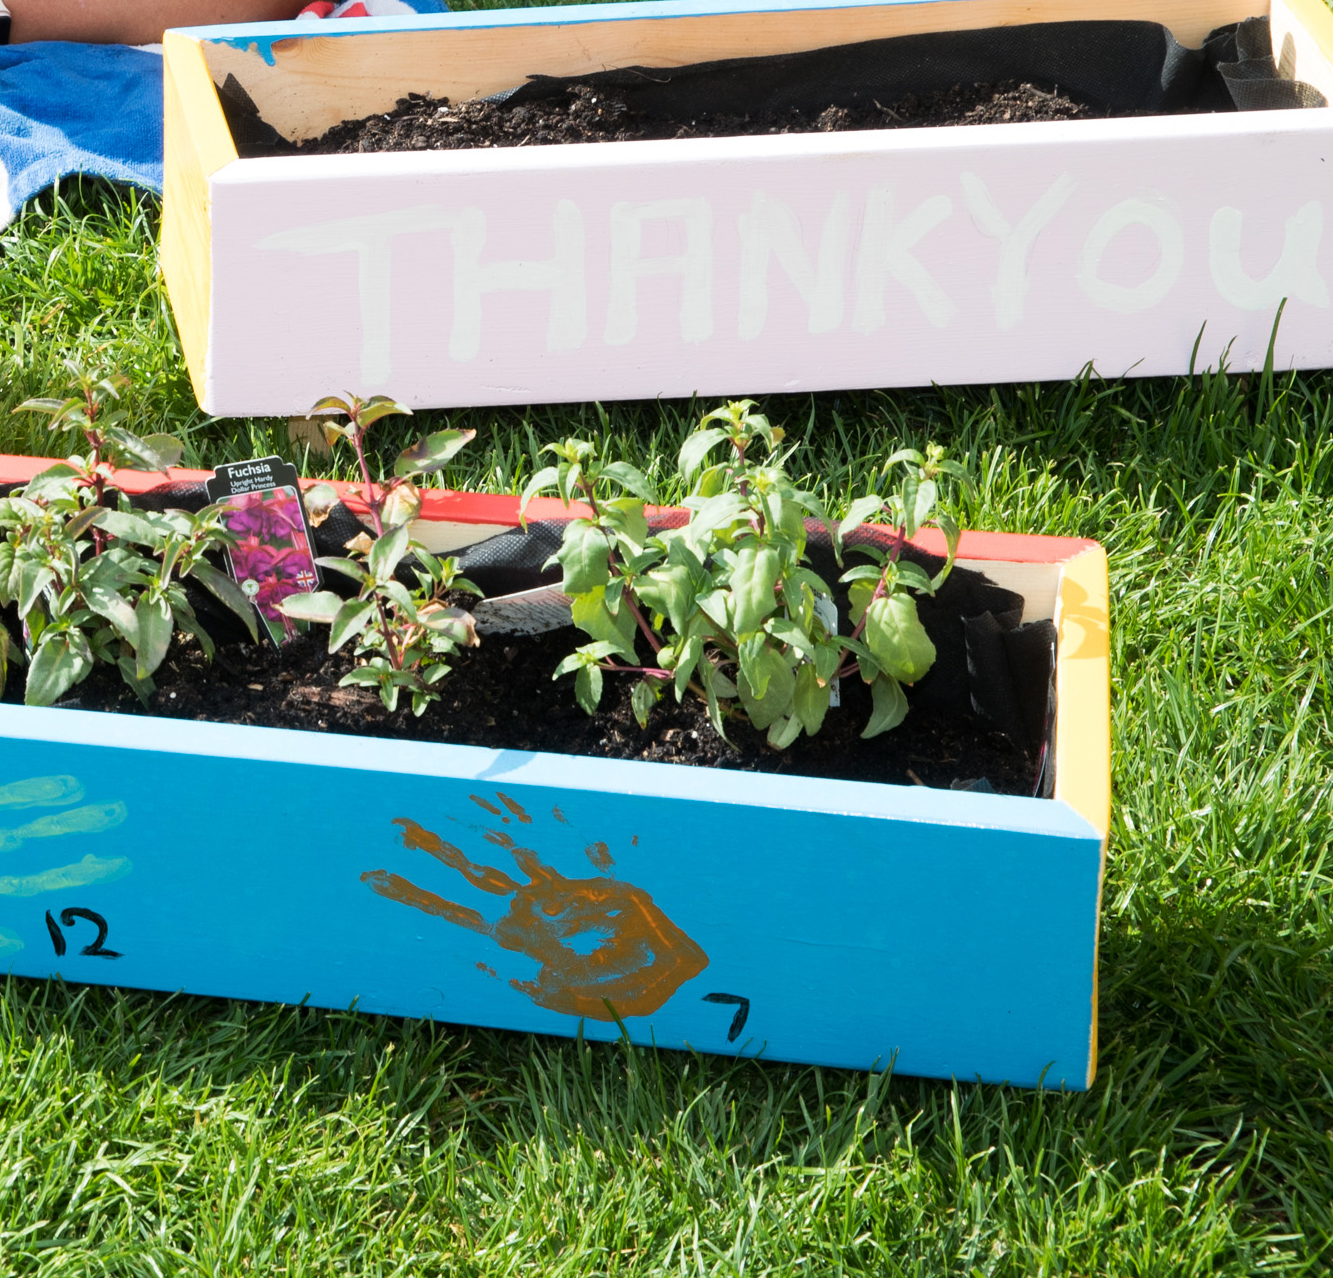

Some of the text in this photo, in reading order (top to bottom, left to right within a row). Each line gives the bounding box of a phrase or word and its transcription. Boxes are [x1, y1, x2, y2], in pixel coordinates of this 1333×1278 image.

[227, 462, 272, 479] Fuchsia
[230, 474, 273, 488] Upright Hardy
[230, 481, 276, 494] Dollar Princess
[45, 907, 125, 960] 12
[701, 992, 750, 1045] 7
